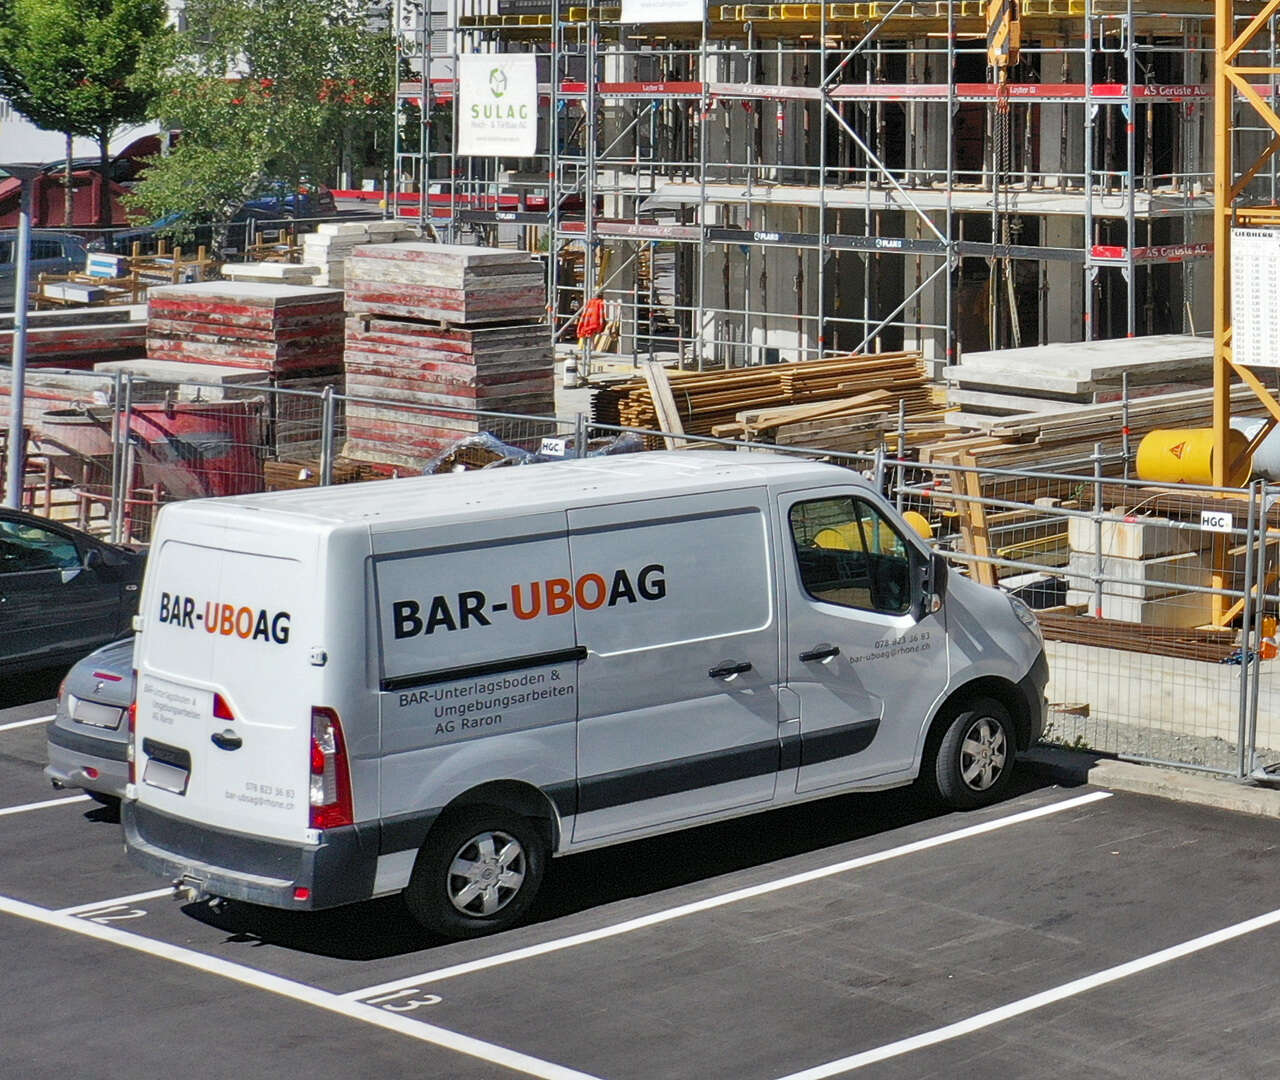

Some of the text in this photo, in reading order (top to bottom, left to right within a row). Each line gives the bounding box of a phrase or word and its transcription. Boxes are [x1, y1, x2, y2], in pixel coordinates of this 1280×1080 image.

[1144, 85, 1156, 95] AS
[1159, 84, 1191, 95] Gerüste
[471, 104, 528, 119] SULAG
[543, 442, 559, 453] HGC
[1202, 517, 1224, 527] HGC
[393, 564, 667, 639] BAR-UBOAG
[159, 592, 291, 644] BAR-UBOAG
[550, 669, 561, 681] &
[434, 683, 575, 718] Umgebungsarbeiten
[435, 714, 502, 735] AG Raron
[366, 988, 443, 1012] 13
